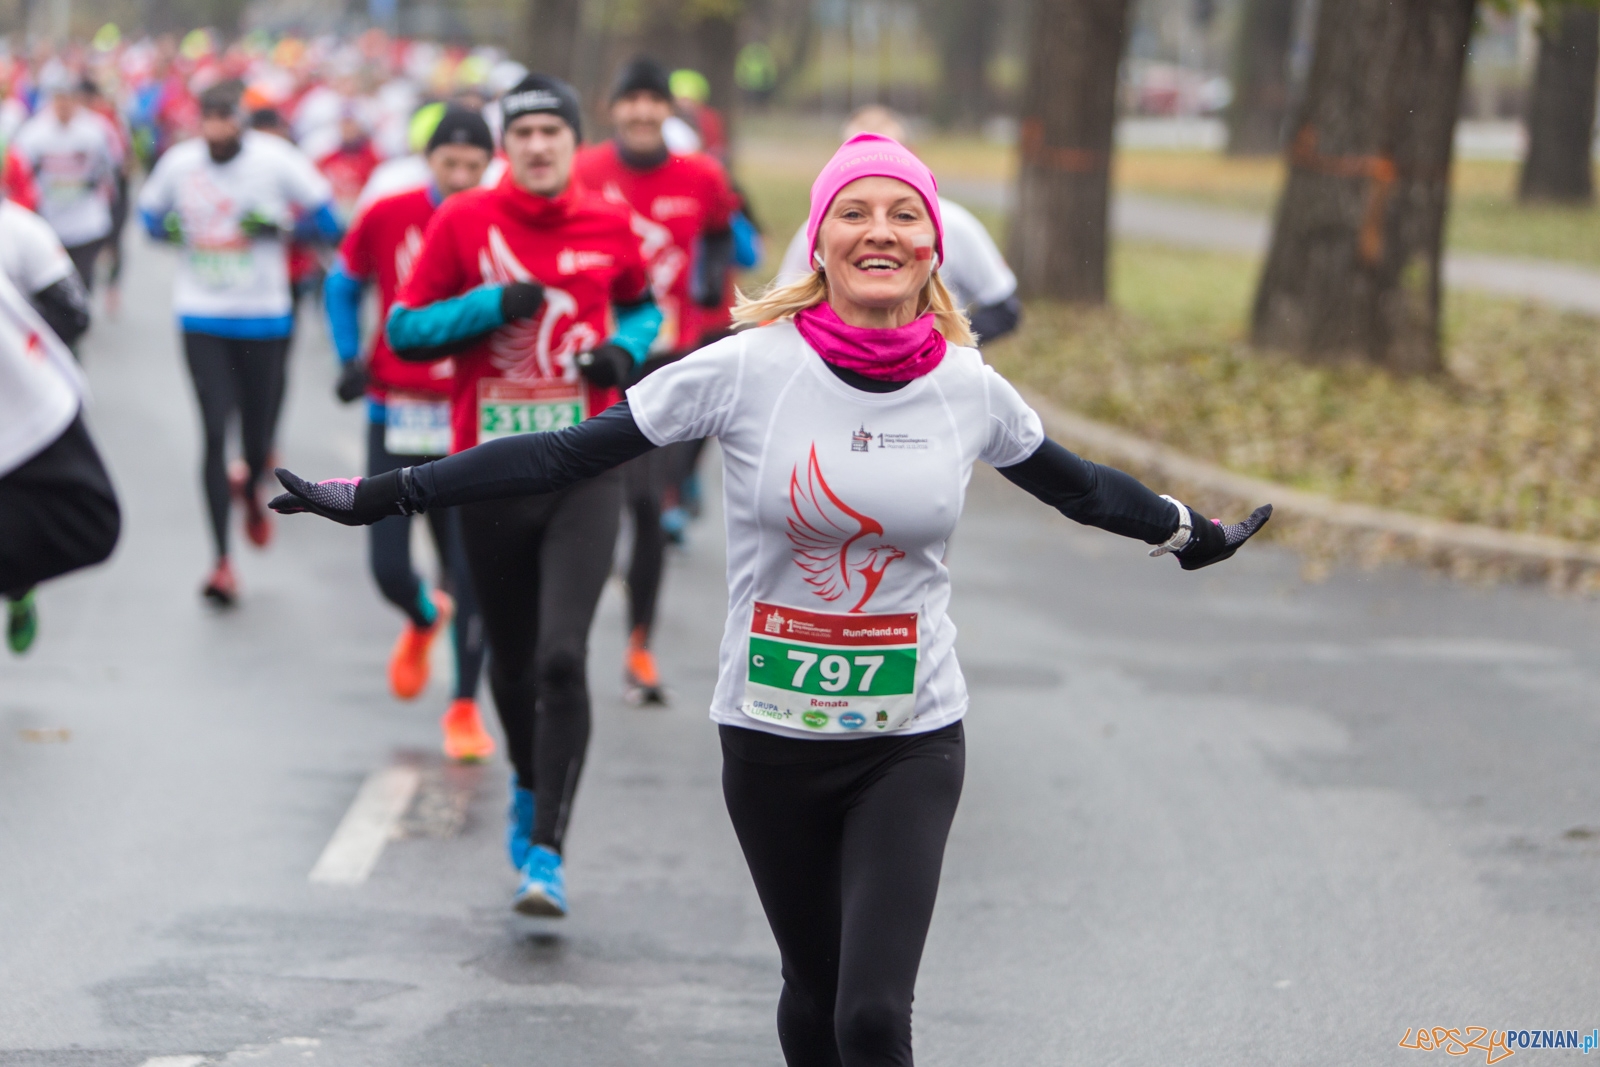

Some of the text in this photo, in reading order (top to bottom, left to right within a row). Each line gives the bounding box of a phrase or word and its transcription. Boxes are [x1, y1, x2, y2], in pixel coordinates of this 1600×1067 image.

[842, 627, 908, 637] RunPoland.org
[786, 649, 885, 693] 797
[752, 700, 779, 712] GRUPA
[810, 698, 850, 708] Renata
[750, 707, 784, 720] LUXMED
